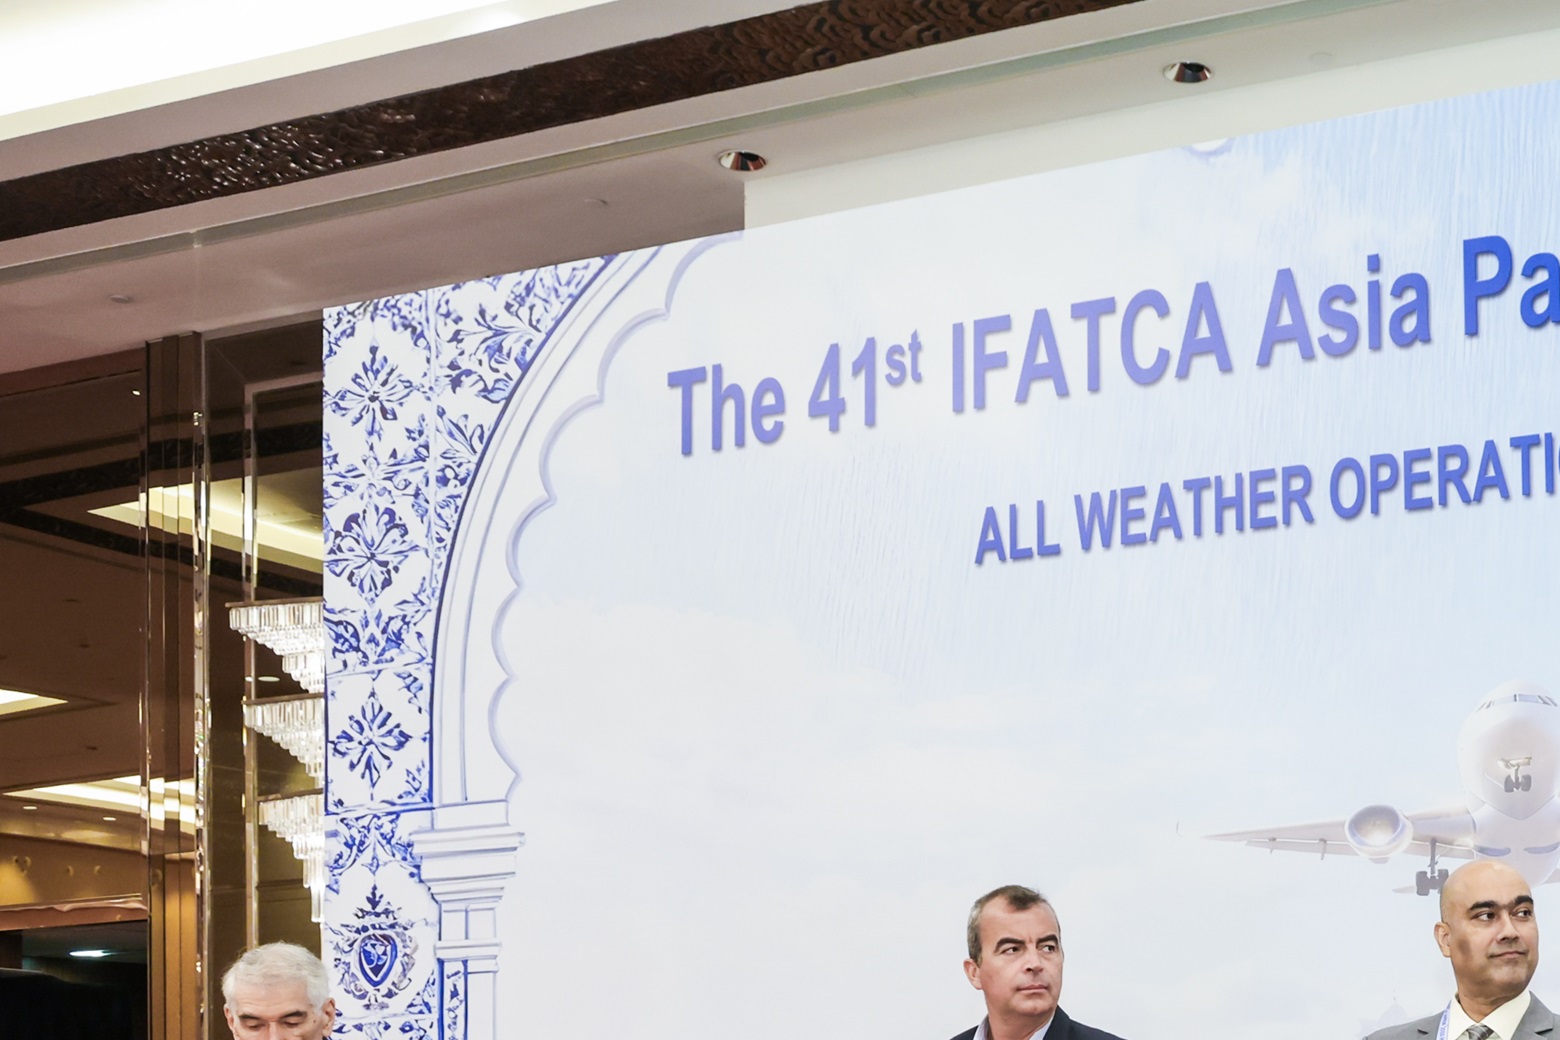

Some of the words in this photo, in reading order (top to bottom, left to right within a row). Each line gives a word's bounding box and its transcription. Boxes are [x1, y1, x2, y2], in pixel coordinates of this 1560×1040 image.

[667, 365, 785, 456] The
[808, 328, 923, 433] 41st
[952, 281, 1233, 413] IFATCA
[1256, 253, 1433, 367] Asia
[975, 499, 1062, 566] ALL
[1074, 464, 1315, 552] WEATHER
